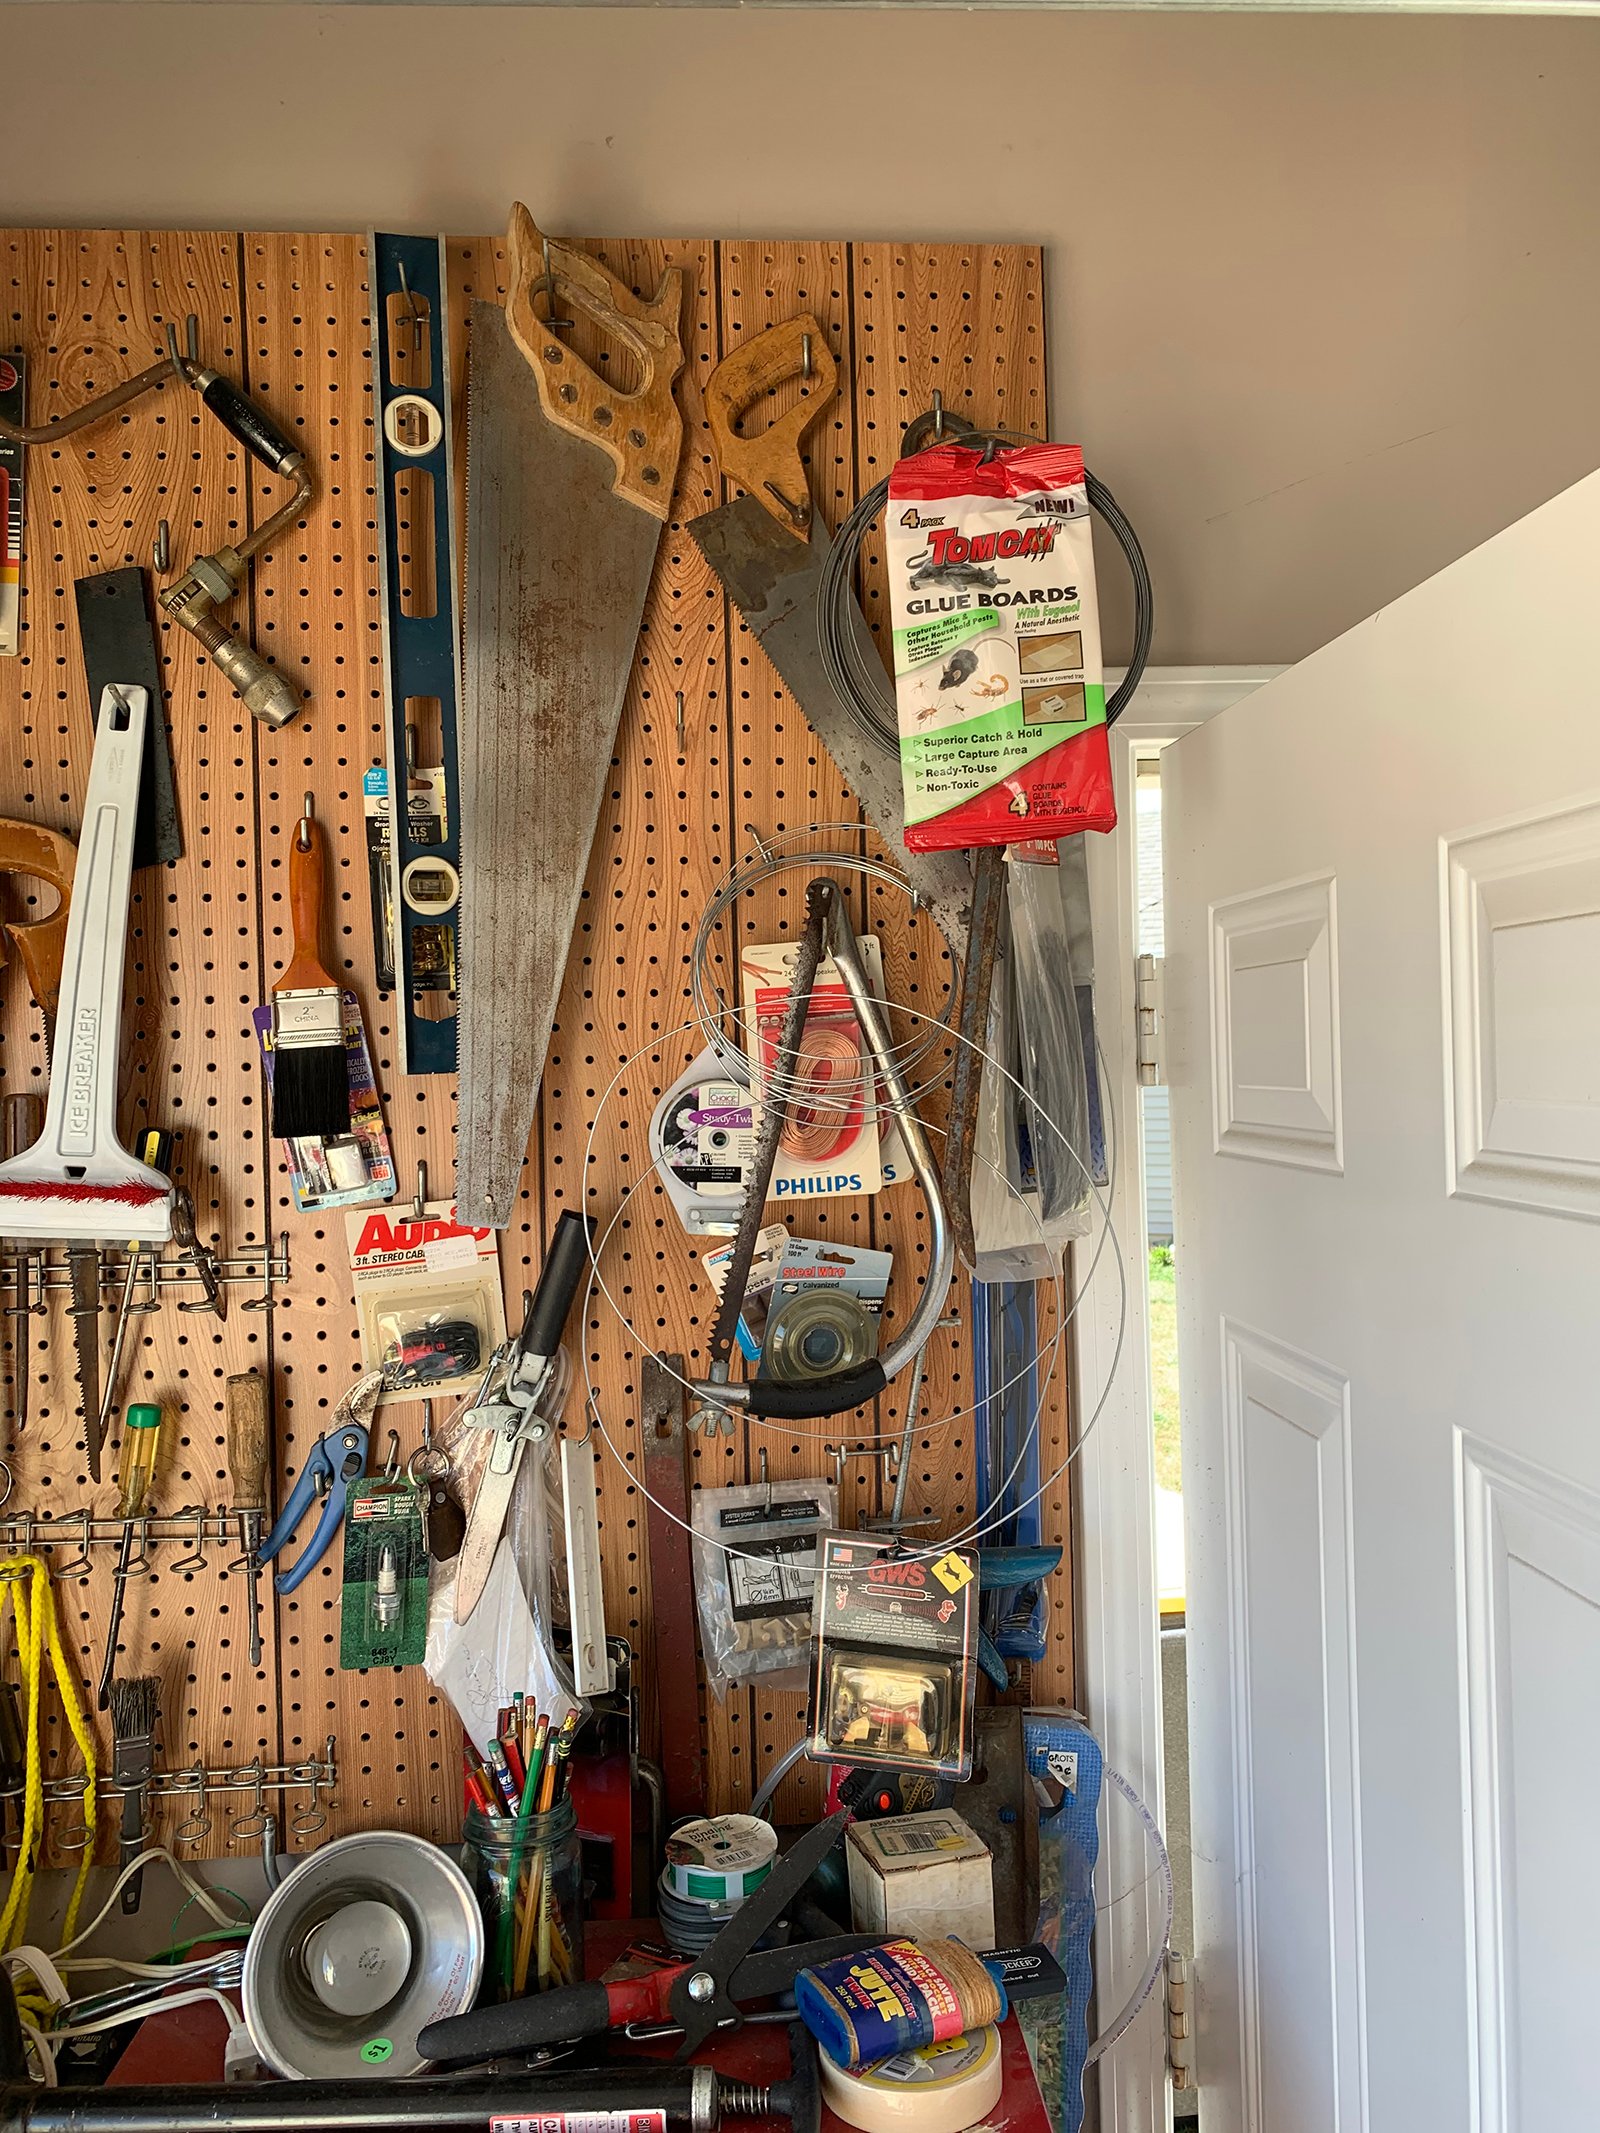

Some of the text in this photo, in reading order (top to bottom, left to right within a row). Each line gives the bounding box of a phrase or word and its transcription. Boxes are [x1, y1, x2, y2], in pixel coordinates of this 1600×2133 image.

[1034, 497, 1075, 514] NEW!
[900, 508, 946, 529] 4 PACK
[906, 586, 1079, 615] GLUE BOARDS
[1016, 599, 1081, 620] With Eugenol
[906, 624, 941, 639] Captures
[942, 617, 960, 627] Mice
[1021, 618, 1045, 629] Natural
[1046, 613, 1081, 626] Anesthetic
[907, 614, 994, 647] Other Household Pests
[1055, 674, 1074, 682] covered
[1074, 673, 1084, 681] trap
[923, 727, 1043, 748] Superior Catch & Hold
[924, 745, 1028, 764] Large Capture Area
[925, 763, 998, 779] Ready-To-Use
[926, 779, 980, 793] Non-Toxic
[1032, 782, 1067, 792] CONTAINS
[1008, 791, 1031, 817] 4
[1032, 792, 1052, 801] GLUE
[1033, 799, 1062, 809] BOARDS
[1034, 808, 1051, 816] WITH
[71, 1008, 97, 1138] ICE BREAKER
[372, 1168, 388, 1180] USA
[775, 1174, 862, 1195] PHILIPS
[355, 1257, 361, 1266] 3
[362, 1256, 370, 1265] ft.
[371, 1251, 404, 1264] STEREO
[782, 1266, 846, 1278] Steel Wire
[356, 1503, 387, 1512] CHAMPION
[867, 1559, 926, 1586] GWS
[688, 1824, 734, 1840] binding
[694, 1834, 719, 1843] wire
[983, 1948, 1021, 1957] MAGNETIC
[438, 1979, 453, 2007] Because
[842, 1976, 876, 2010] TWINE
[849, 1965, 906, 2022] JUTE
[891, 1954, 941, 2018] HANDY PACK
[914, 1957, 957, 2014] SPACE SAVER
[843, 1996, 858, 2010] Feet
[926, 1978, 949, 2015] POCKET
